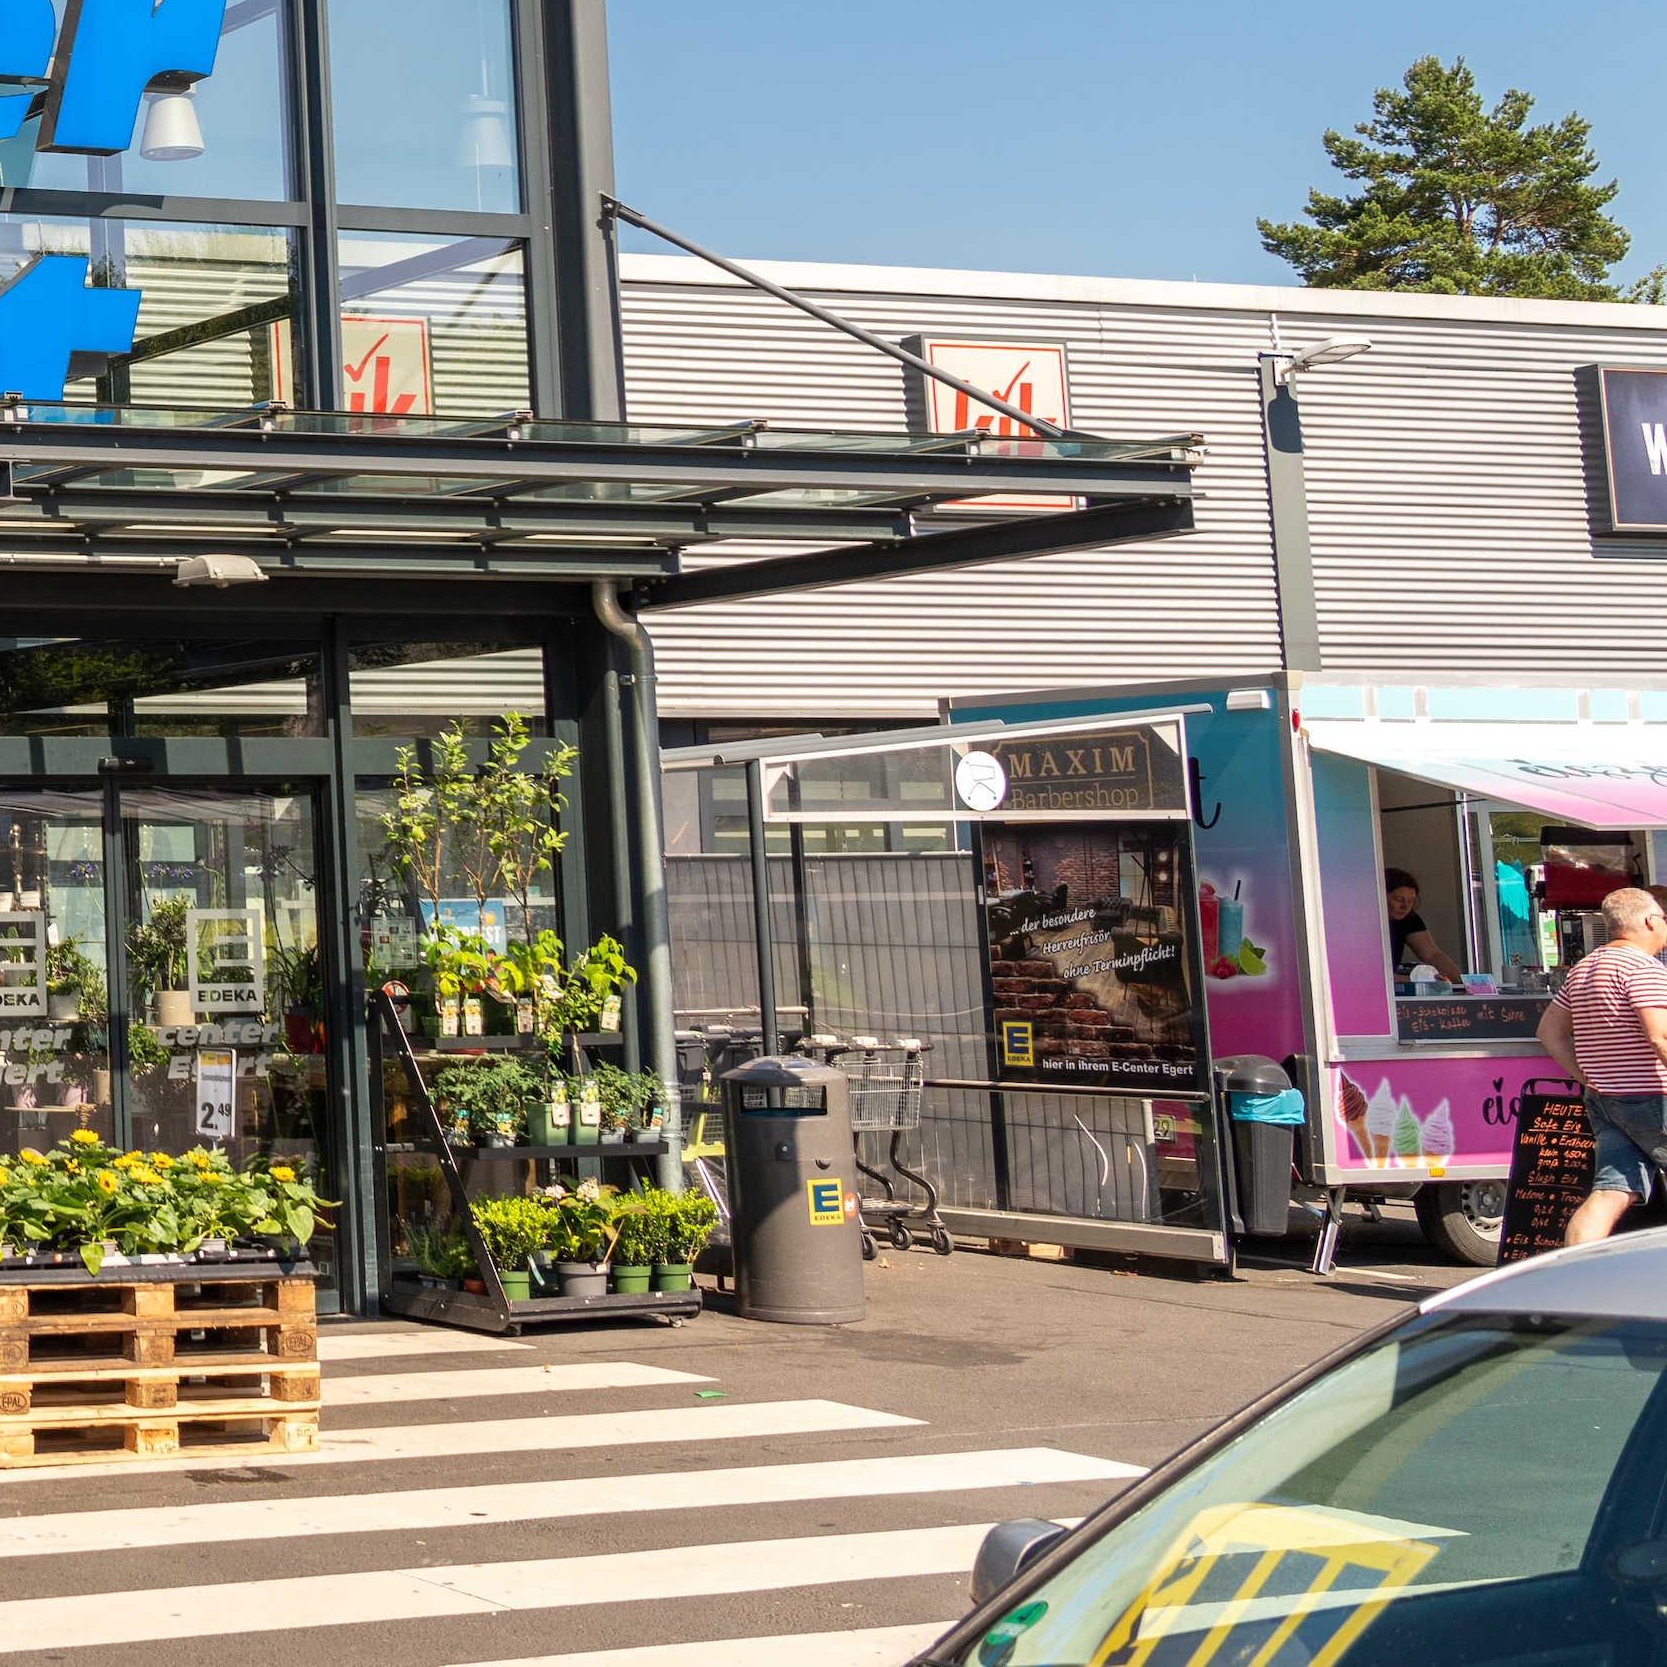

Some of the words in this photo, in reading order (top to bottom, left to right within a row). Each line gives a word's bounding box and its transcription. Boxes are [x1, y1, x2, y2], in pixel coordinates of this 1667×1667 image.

[1007, 746, 1137, 780] MAXIM
[1011, 783, 1139, 811] Barbershop
[1021, 918, 1040, 933] der
[1042, 907, 1097, 930] besondere
[1042, 929, 1111, 956] Herrenfrisör
[1063, 963, 1092, 979] ohne
[1093, 945, 1176, 972] Terminpflicht!
[198, 989, 257, 1003] EDEKA
[157, 1020, 281, 1046] center
[167, 1050, 273, 1082] Ert
[1042, 1059, 1064, 1069] hier
[1065, 1059, 1075, 1070] in
[1078, 1060, 1109, 1071] ihrem
[1112, 1061, 1160, 1073] E-Center
[1162, 1063, 1194, 1076] Egert
[1543, 1102, 1588, 1117] HEUTE:
[1562, 1120, 1582, 1133] Eis
[1520, 1133, 1548, 1146] Vanille
[1528, 1171, 1556, 1184] Slush
[1560, 1173, 1579, 1184] Eis
[1515, 1188, 1545, 1200] Melone
[1513, 1233, 1529, 1245] Eis
[1511, 1249, 1528, 1260] Eis
[289, 1335, 311, 1347] EPAL
[2, 1397, 22, 1408] EPAL
